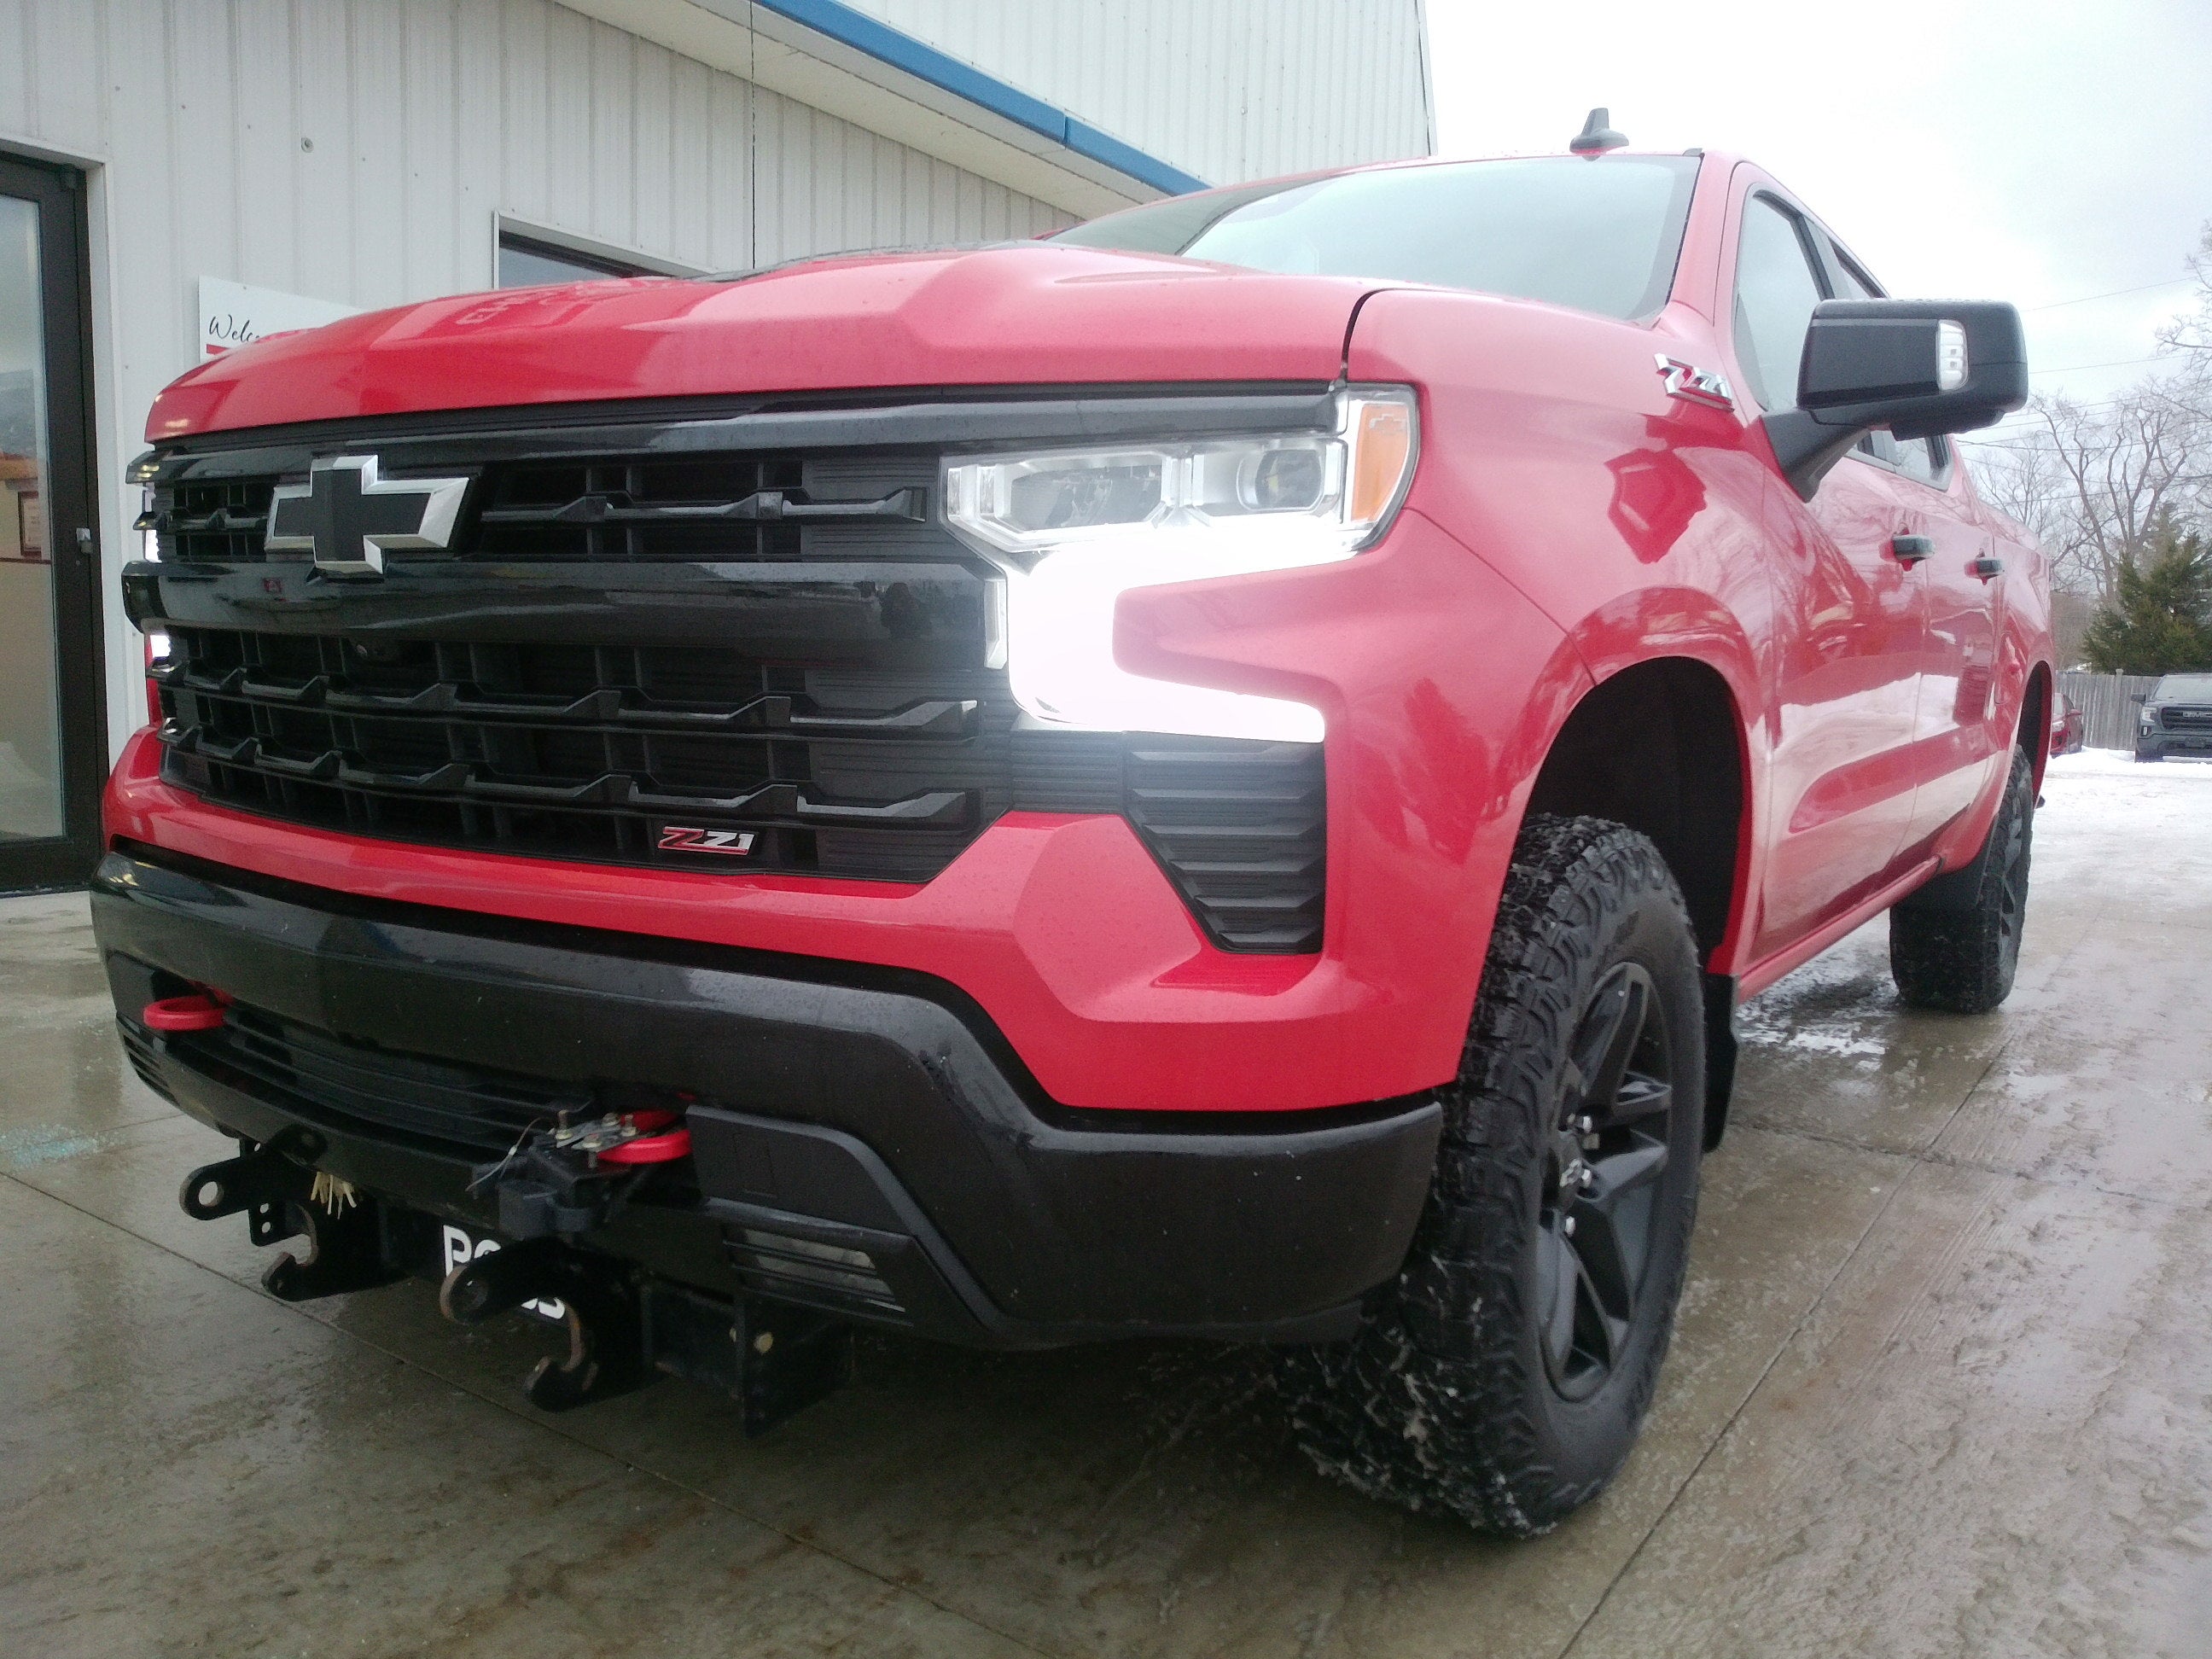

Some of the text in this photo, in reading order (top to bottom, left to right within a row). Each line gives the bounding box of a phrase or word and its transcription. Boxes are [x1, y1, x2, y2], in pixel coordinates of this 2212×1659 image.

[208, 313, 260, 343] Welc
[1654, 352, 1735, 412] Z71
[657, 825, 755, 856] Z71
